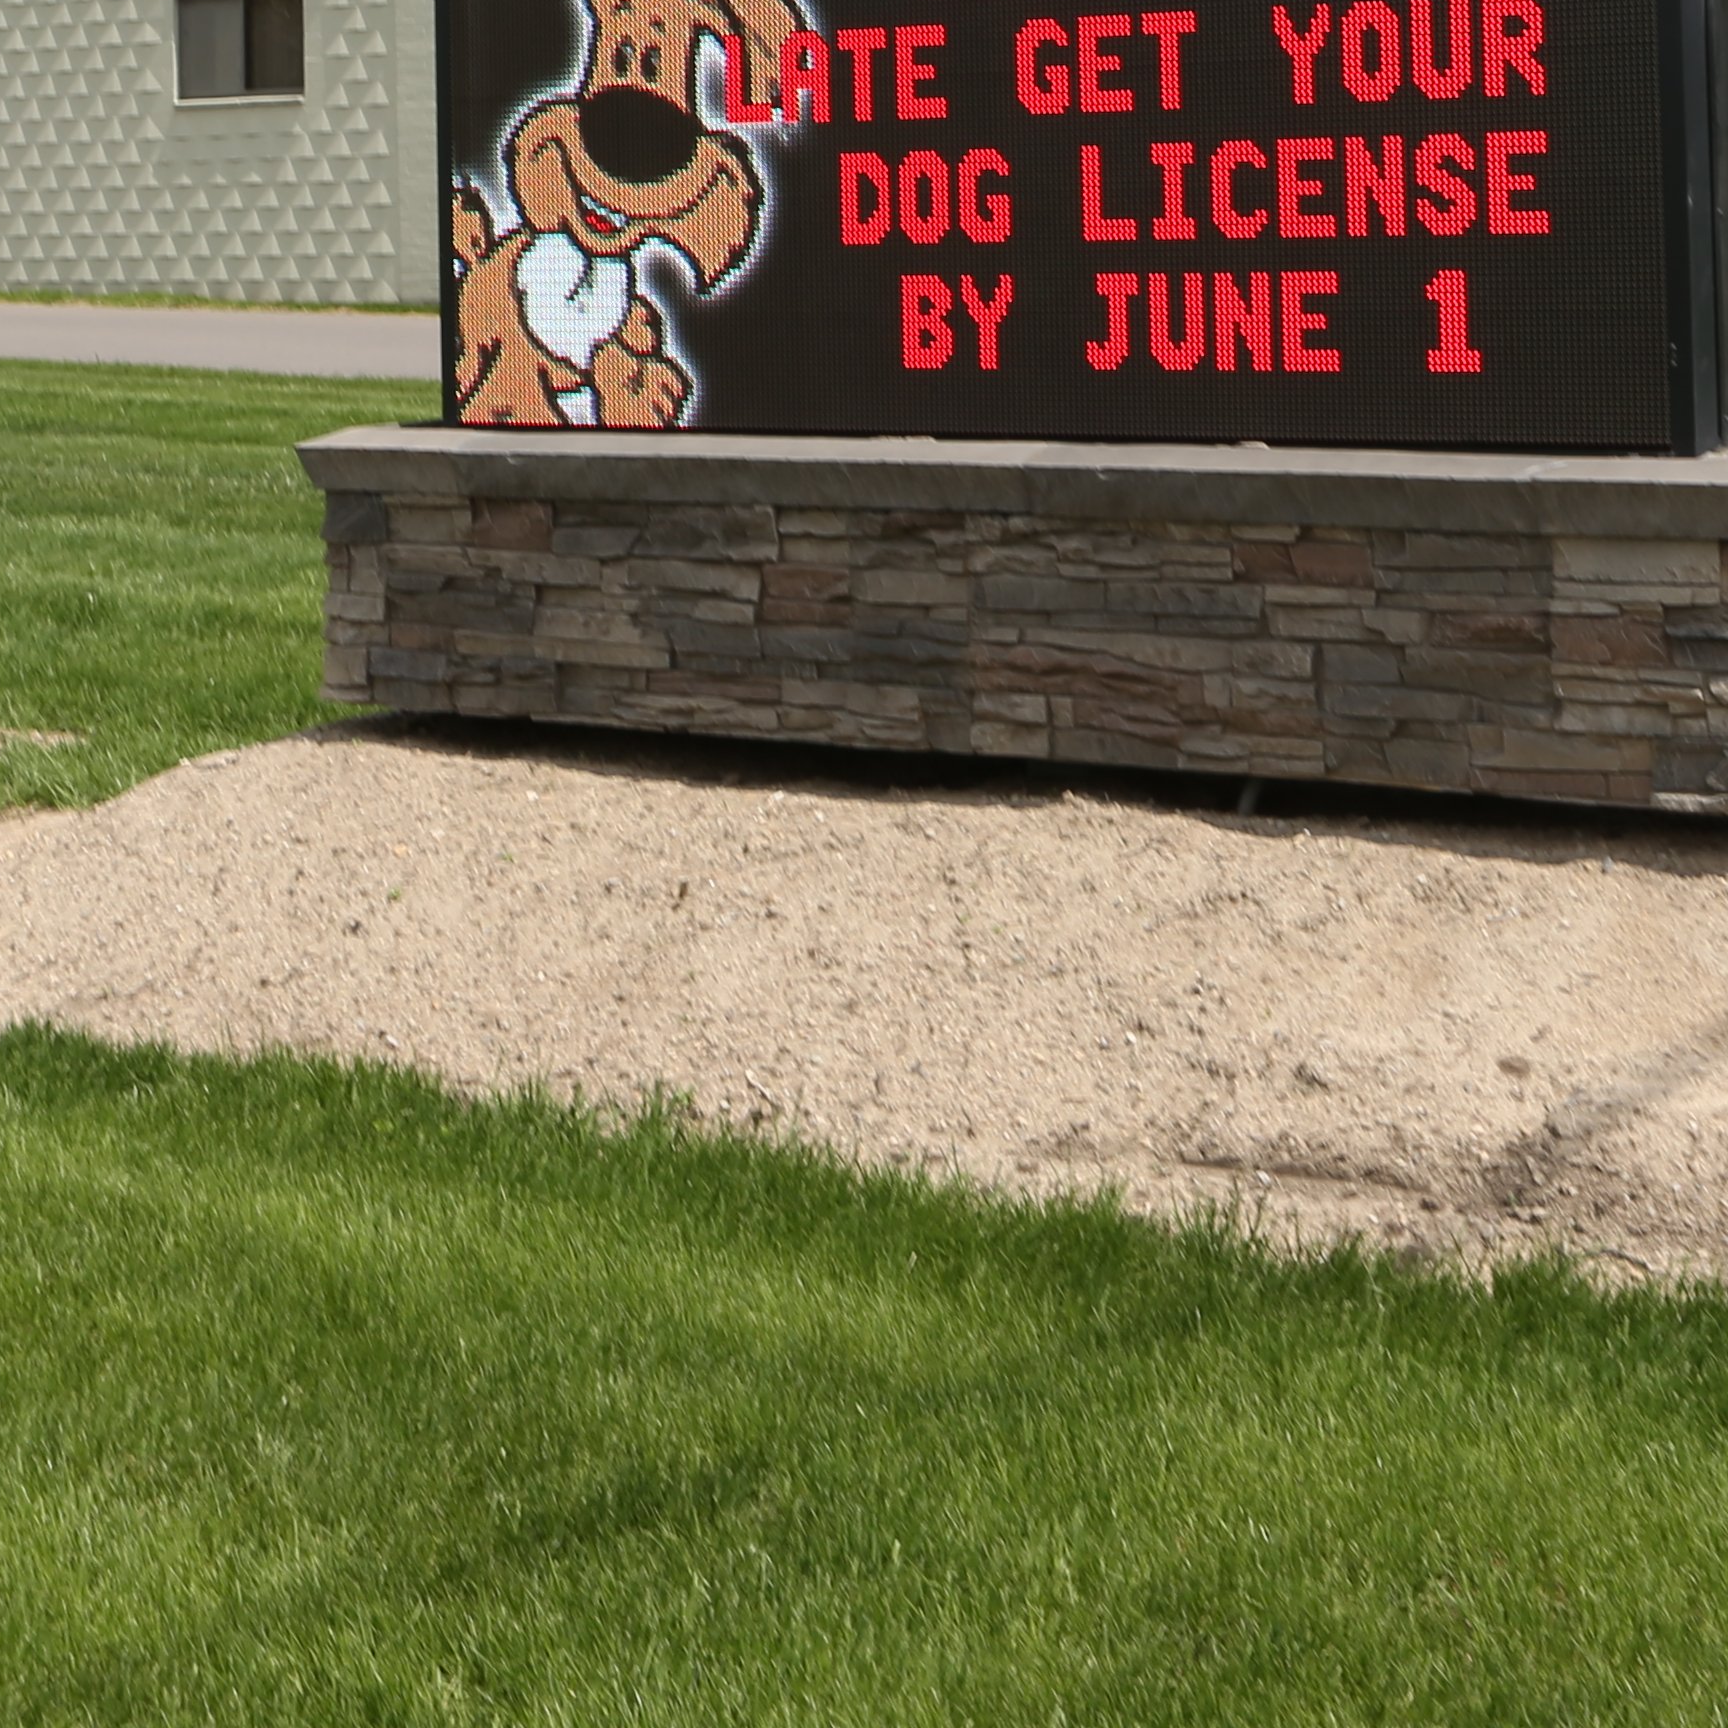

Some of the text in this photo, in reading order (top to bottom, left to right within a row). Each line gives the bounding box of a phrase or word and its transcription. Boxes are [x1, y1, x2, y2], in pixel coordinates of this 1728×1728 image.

[721, 23, 949, 124] LATE
[1014, 10, 1198, 116] GET
[838, 129, 1552, 246] DOG LICENSE
[900, 268, 1484, 374] BY JUNE 1
